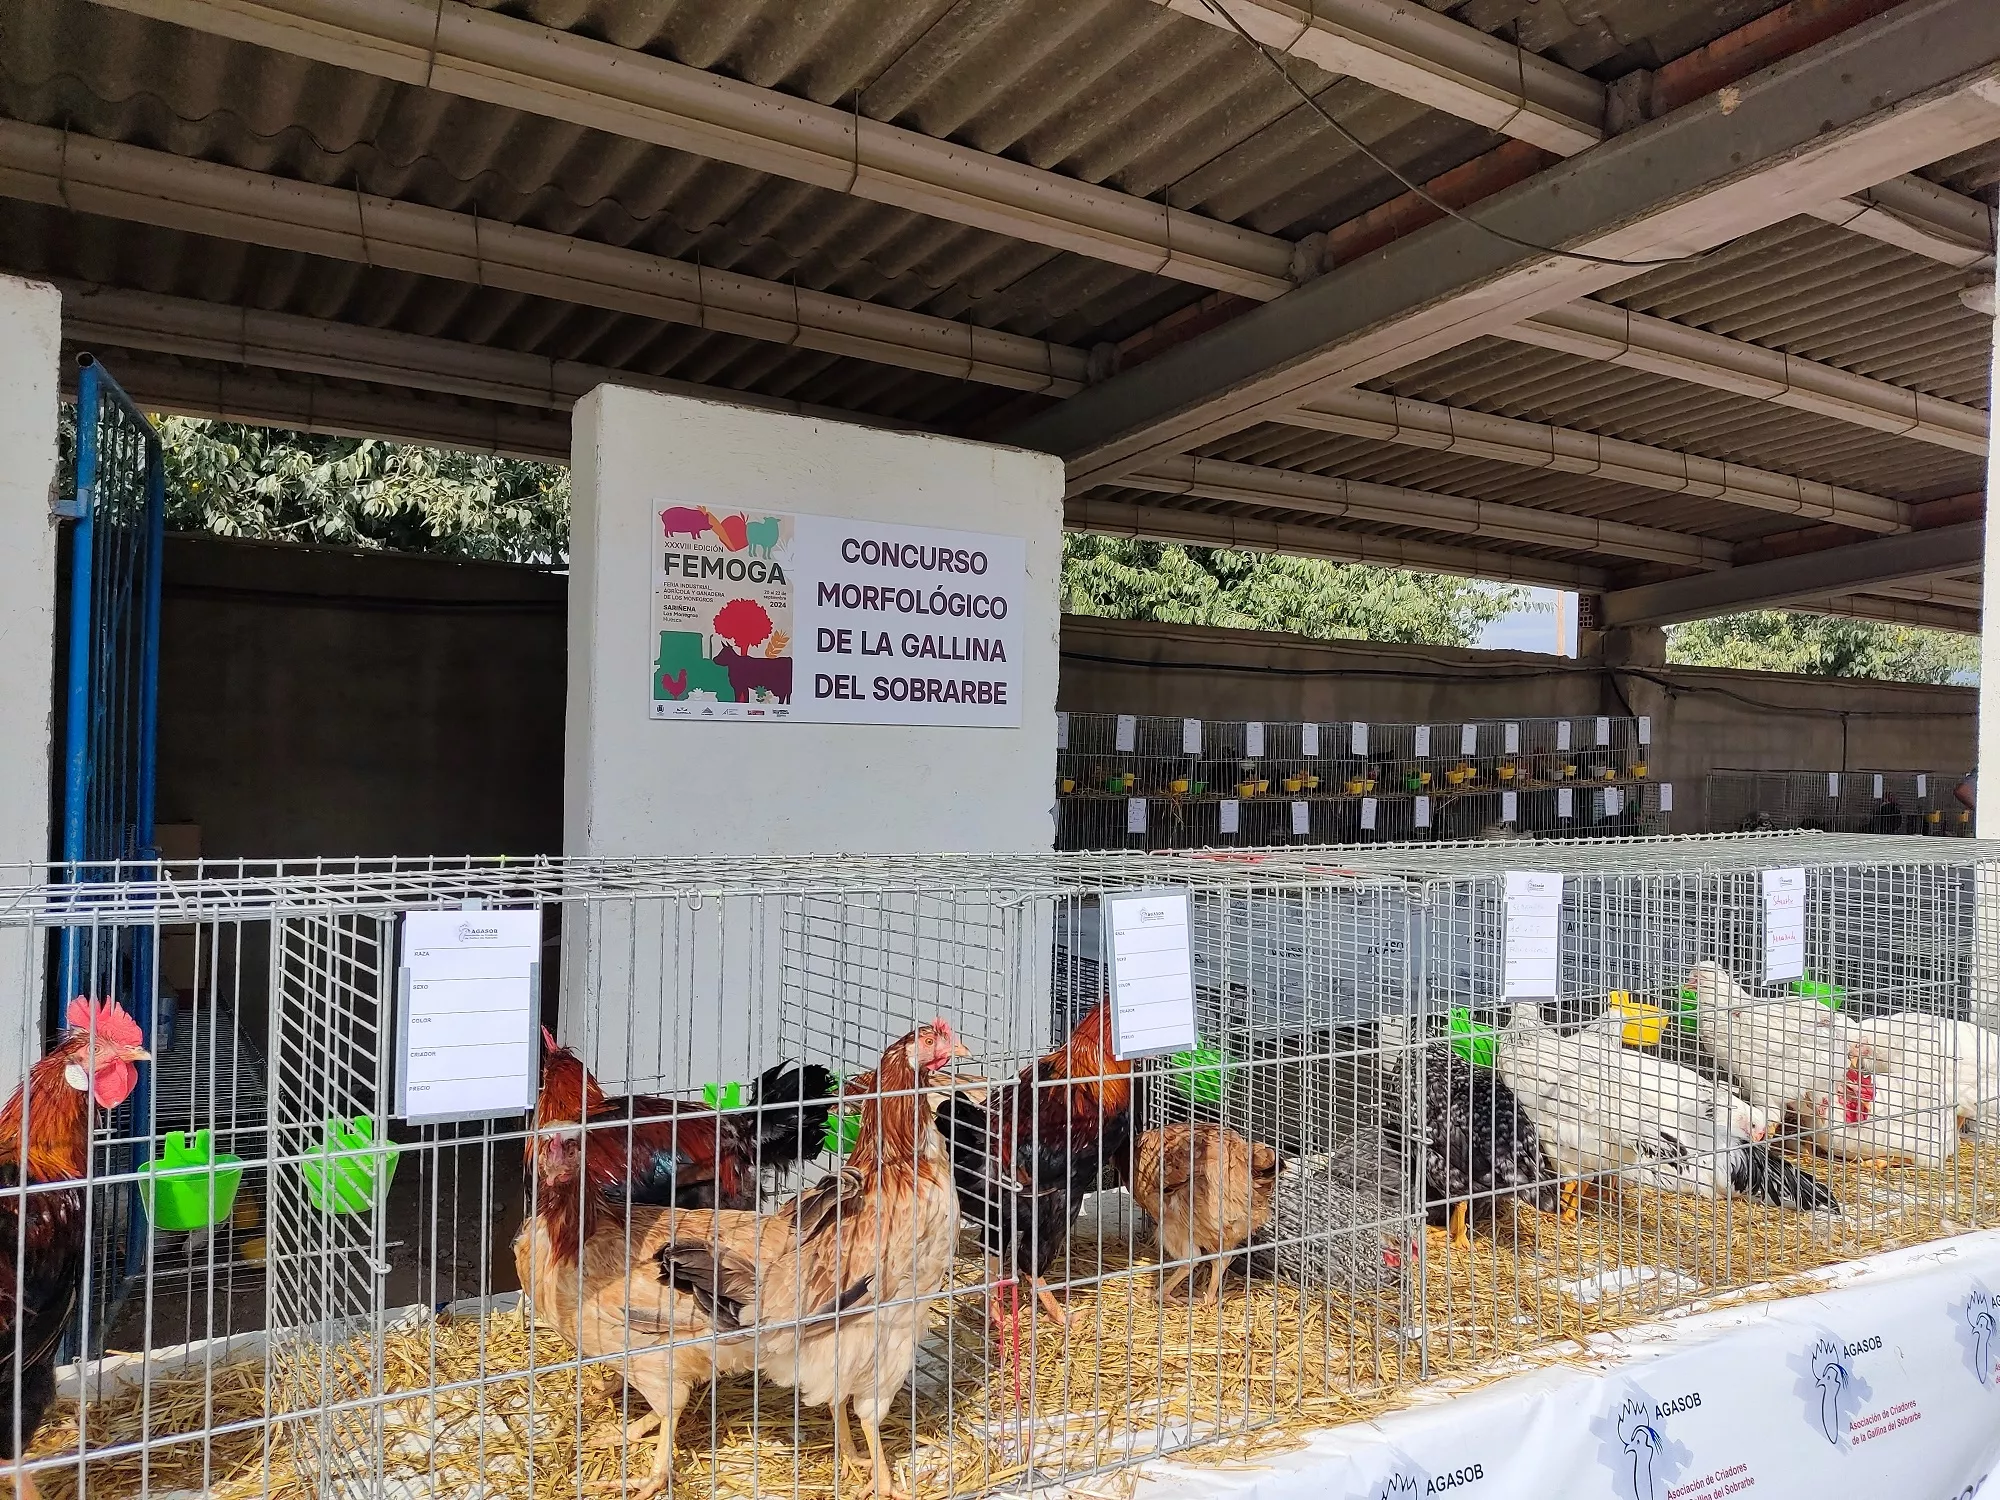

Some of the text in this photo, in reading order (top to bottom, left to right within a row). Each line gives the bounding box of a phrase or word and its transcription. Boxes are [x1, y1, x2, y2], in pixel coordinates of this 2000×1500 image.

[664, 541, 724, 553] XXXVIII EDICIÓN
[841, 537, 988, 575] CONCURSO
[664, 552, 787, 585] FEMOGA
[663, 604, 696, 612] SARIÑENA
[816, 581, 1008, 620] MORFOLÓGICO
[816, 627, 1007, 663] DE LA GALLINA
[814, 673, 1008, 705] DEL SOBRARBE
[1842, 1335, 1883, 1359] AGASOB
[1655, 1392, 1702, 1420] AGASOB
[1849, 1399, 1917, 1432] Asociación de Criadores
[1851, 1435, 1860, 1446] de
[1866, 1426, 1887, 1441] Gallina
[1887, 1420, 1897, 1433] del
[1896, 1411, 1922, 1428] Sobrarbe
[1426, 1463, 1484, 1496] AGASOB
[1667, 1462, 1748, 1500] Asociación de Criadores
[1713, 1489, 1725, 1500] del
[1724, 1476, 1755, 1495] Sobrarbe
